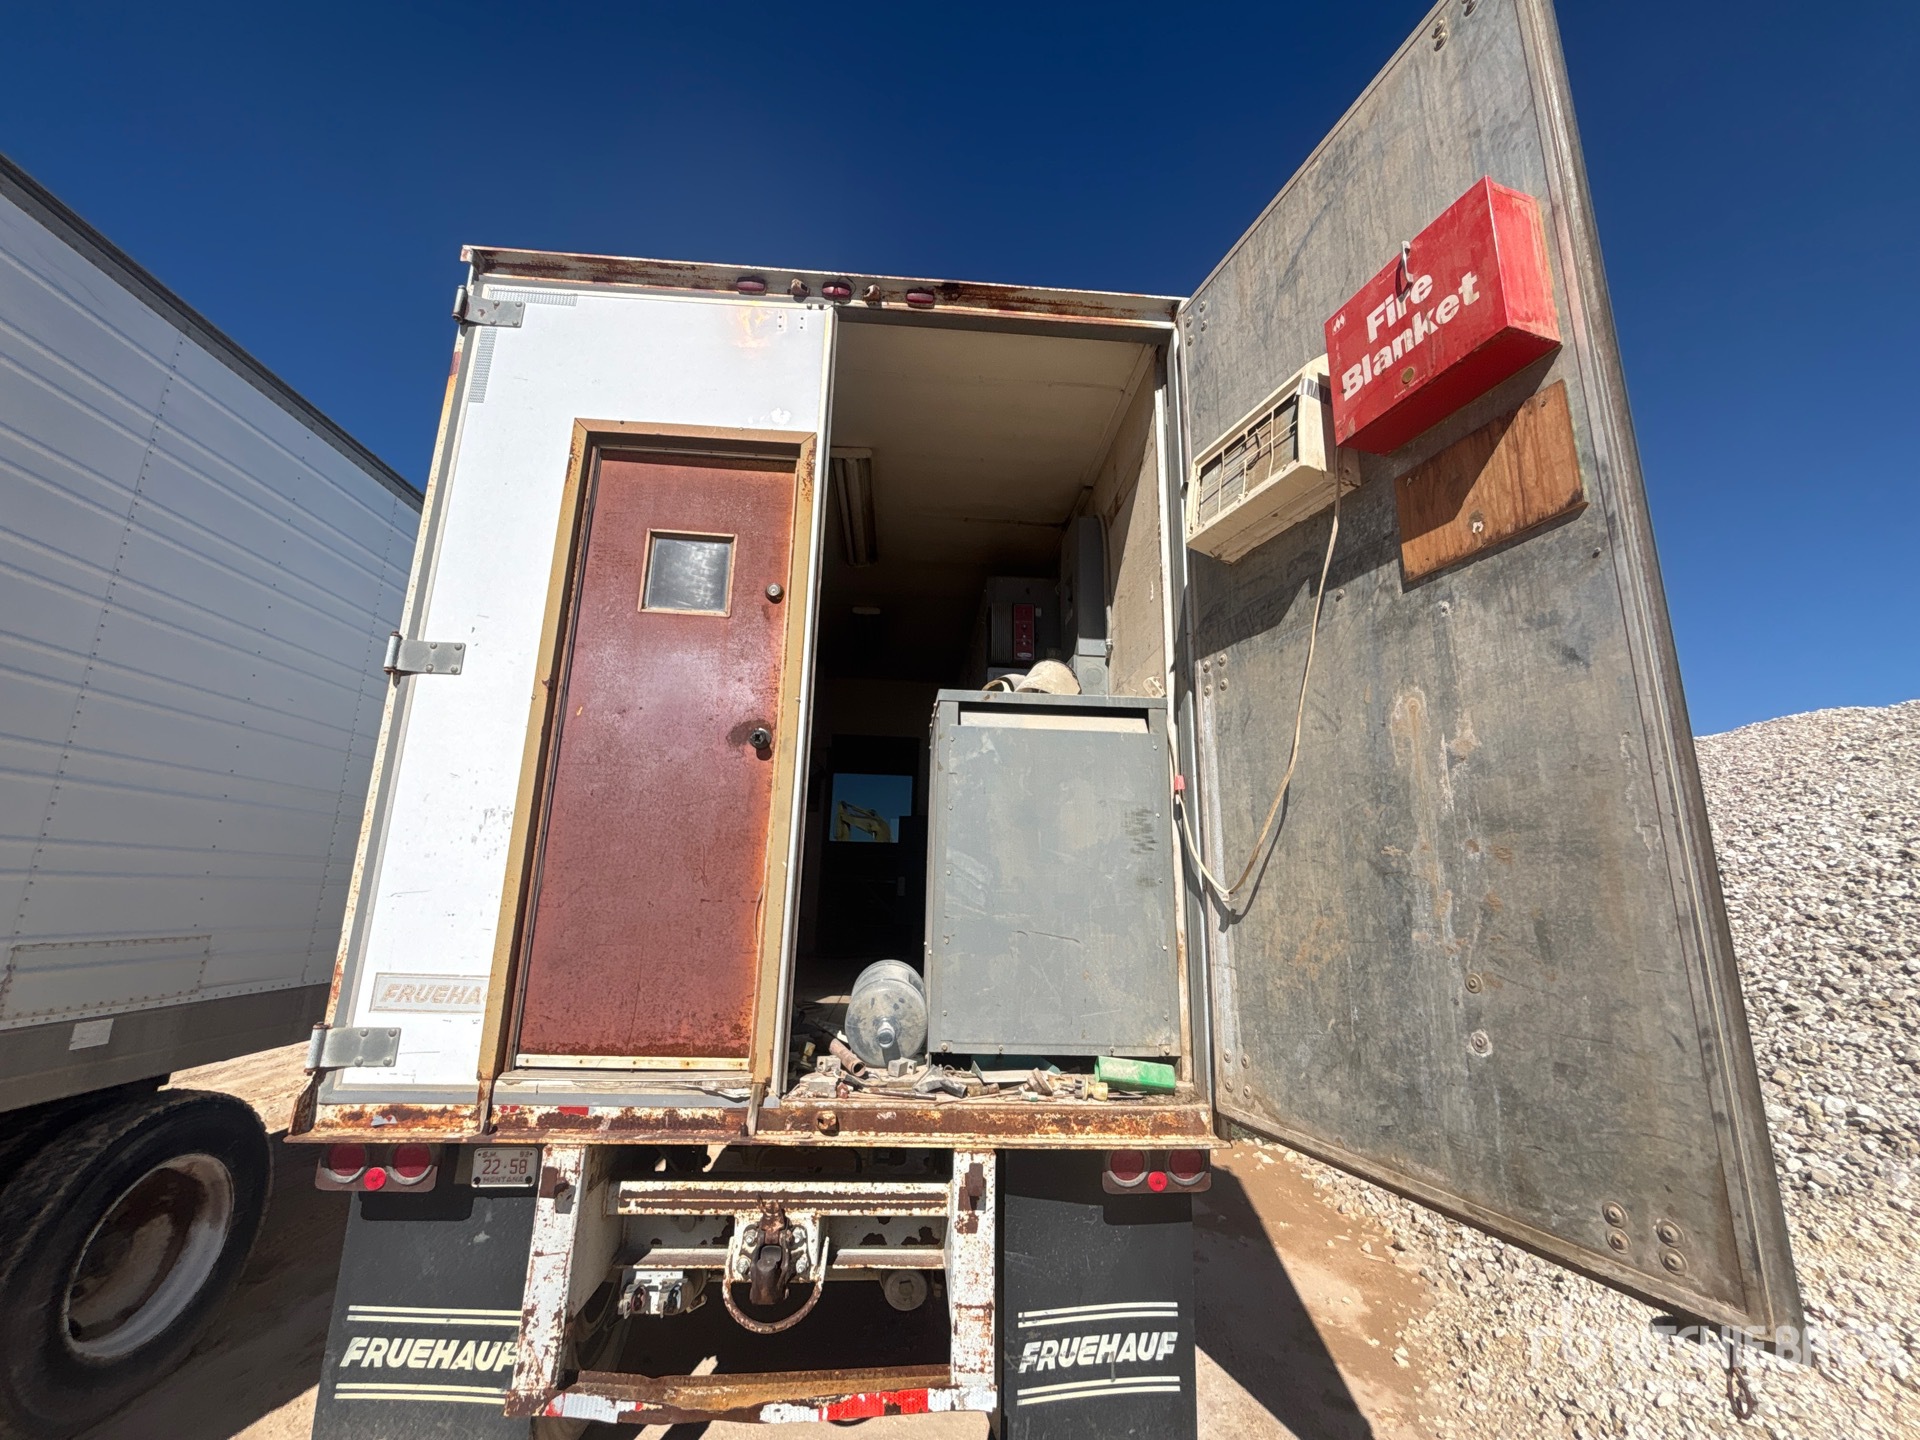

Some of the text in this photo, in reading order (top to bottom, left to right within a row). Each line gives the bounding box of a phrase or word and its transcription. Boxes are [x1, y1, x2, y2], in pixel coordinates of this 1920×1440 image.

[1366, 274, 1433, 344] Fire
[1341, 271, 1481, 401] Blanket
[381, 983, 488, 1004] FRUEHA
[338, 1336, 519, 1373] FRUEHAUF
[1017, 1331, 1179, 1374] FRUEHAUF
